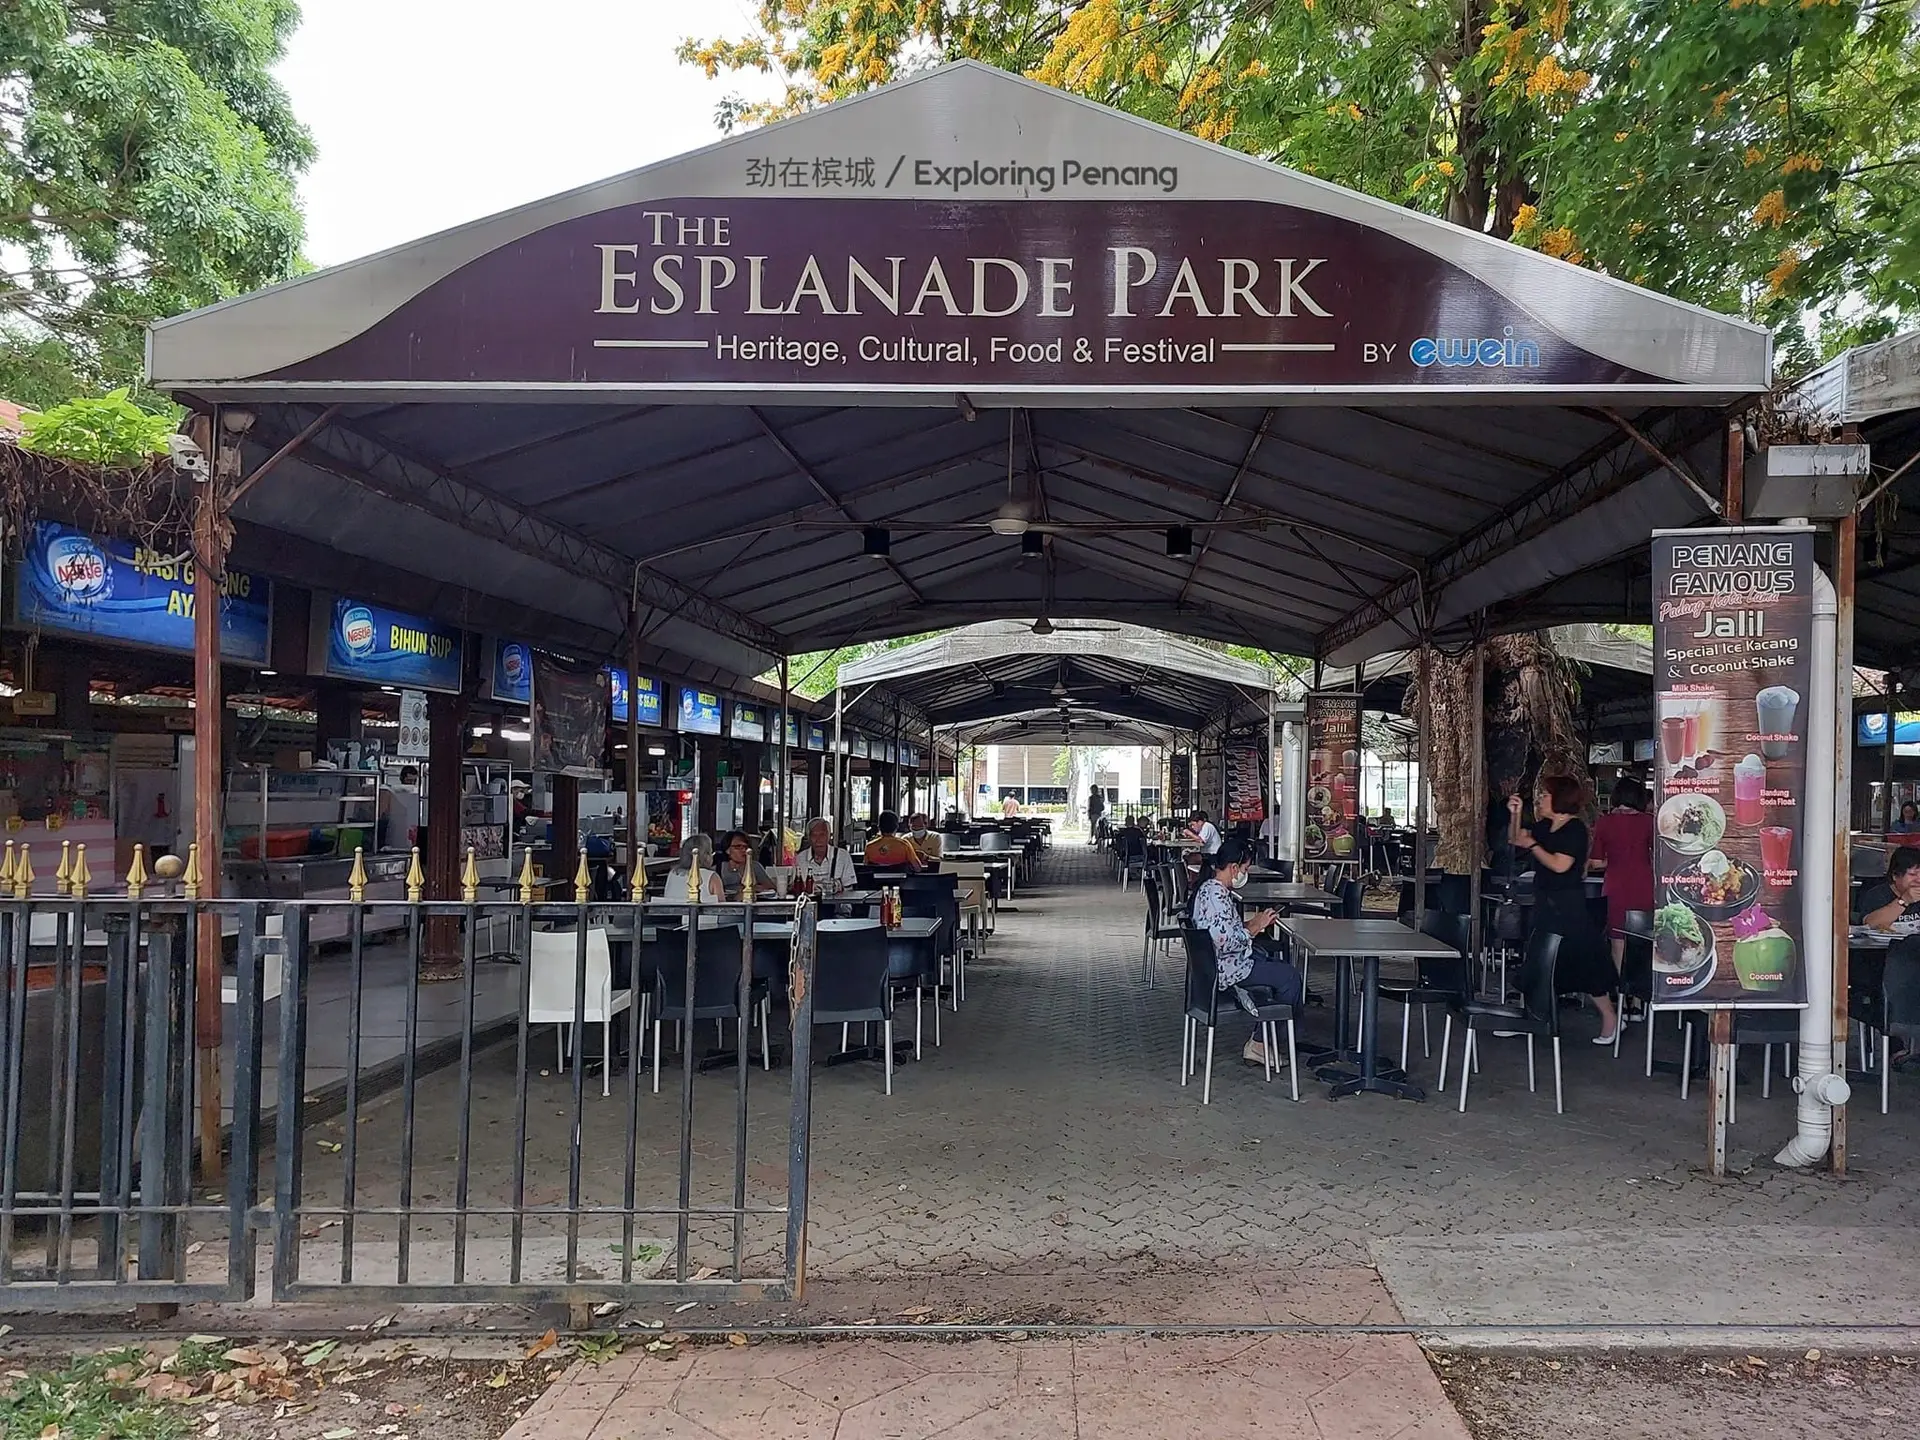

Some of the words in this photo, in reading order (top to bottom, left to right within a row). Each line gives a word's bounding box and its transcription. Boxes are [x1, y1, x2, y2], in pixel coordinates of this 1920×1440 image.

[642, 211, 731, 247] THE
[593, 244, 1077, 317] ESPLANADE
[1107, 247, 1334, 317] PARK
[716, 336, 847, 365] Heritage,
[858, 336, 978, 364] Cultural,
[990, 337, 1065, 363] Food
[1072, 337, 1093, 363] &
[1104, 336, 1216, 363] Festival
[1363, 343, 1397, 363] BY
[1409, 325, 1541, 367] ewein
[1672, 543, 1793, 568] PENANG
[1670, 571, 1794, 595] FAMOUS
[1659, 599, 1705, 622] Padang
[1693, 610, 1764, 638] Jalil
[390, 625, 428, 654] BIHUN
[429, 635, 452, 658] SUP
[1666, 644, 1718, 661] Special
[1723, 643, 1741, 654] Ice
[1746, 638, 1798, 652] Kacang
[1667, 665, 1684, 678] &
[1690, 659, 1748, 675] Coconut
[1751, 655, 1795, 668] Shake
[1672, 684, 1689, 692] Milk
[1690, 684, 1715, 692] Shake
[1322, 723, 1347, 733] Jalil
[1664, 786, 1680, 794] with
[1692, 778, 1720, 787] Special
[1661, 876, 1674, 884] Ice
[1764, 869, 1776, 877] Air
[1666, 976, 1694, 985] Cendol
[1749, 972, 1784, 981] Coconut
